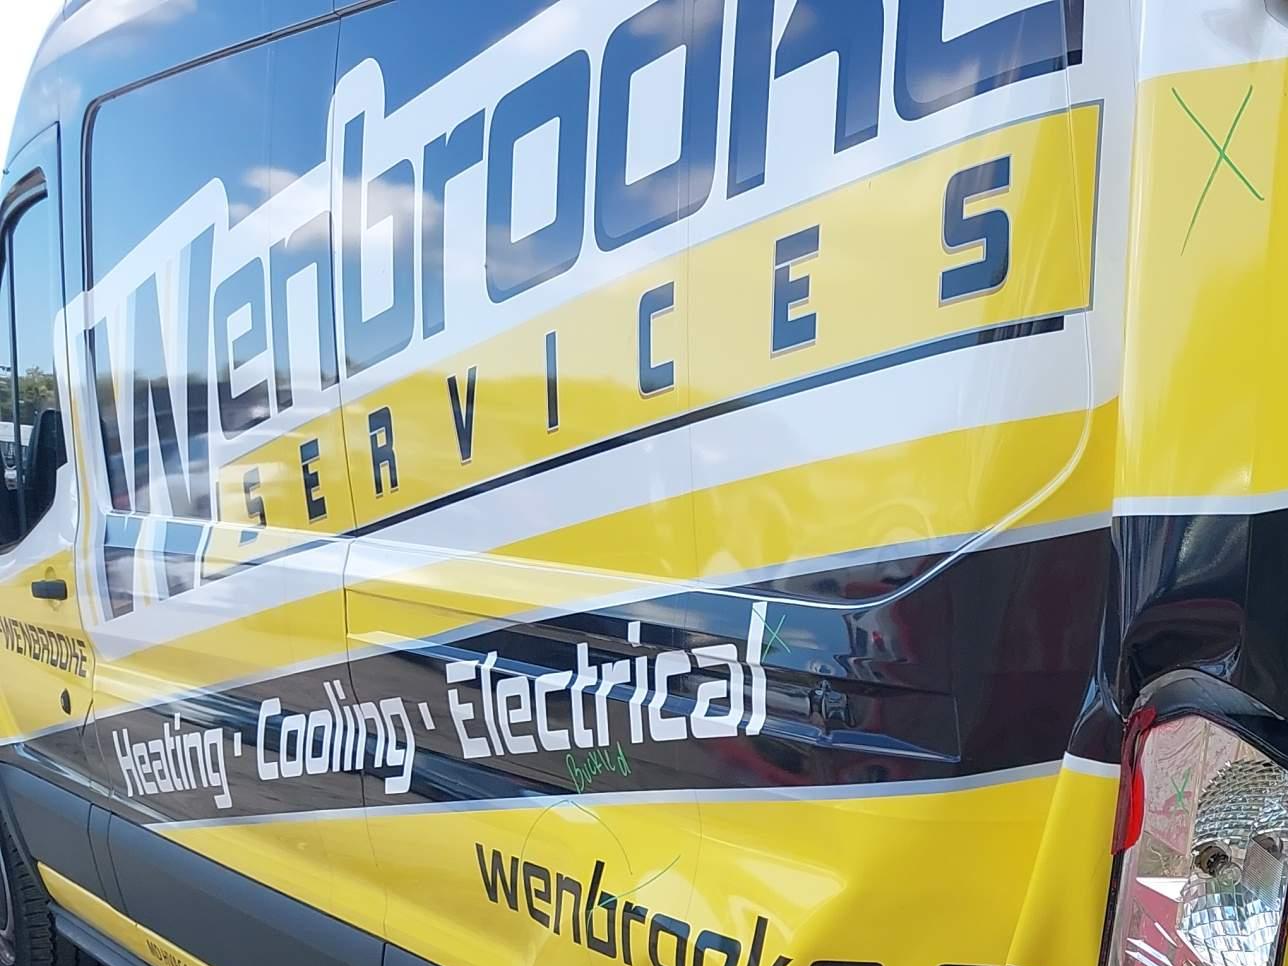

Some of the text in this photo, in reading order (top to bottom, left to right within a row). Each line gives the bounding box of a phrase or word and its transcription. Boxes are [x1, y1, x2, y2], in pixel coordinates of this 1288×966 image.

[237, 153, 1012, 547] SERVICES
[112, 601, 768, 809] Heating Cooling Electrical
